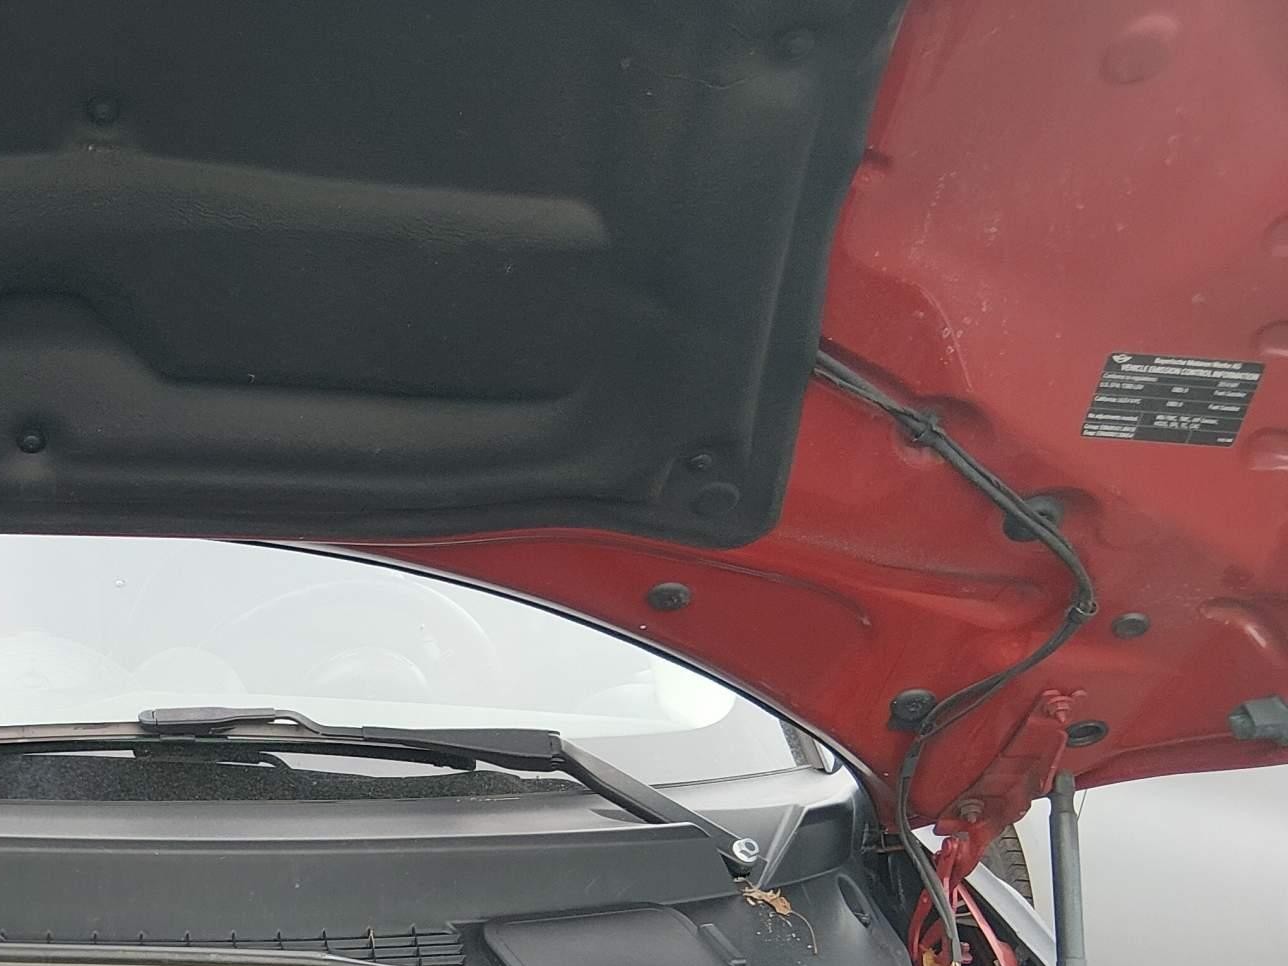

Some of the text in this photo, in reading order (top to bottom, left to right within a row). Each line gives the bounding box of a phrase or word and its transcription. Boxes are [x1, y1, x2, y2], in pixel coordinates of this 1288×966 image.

[1121, 363, 1148, 373] VEHICLE
[1148, 365, 1180, 375] EMISSION
[1181, 368, 1213, 378] CONTROL
